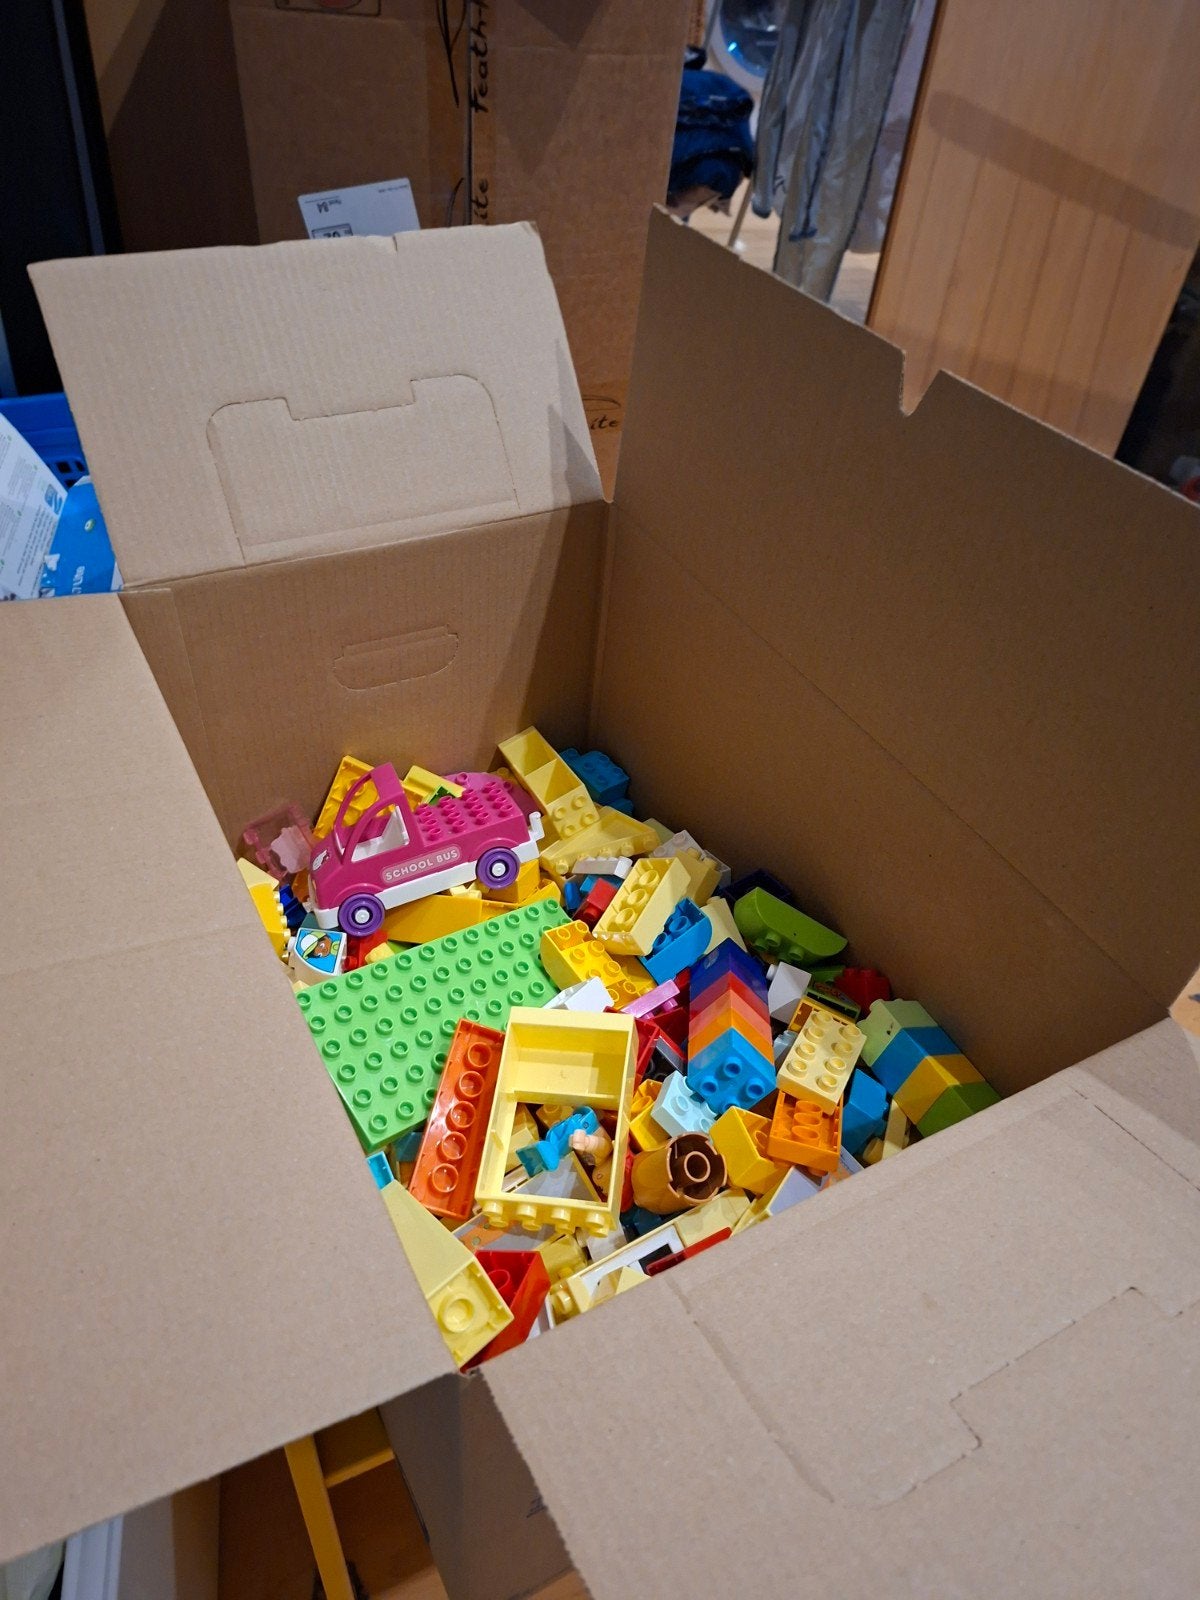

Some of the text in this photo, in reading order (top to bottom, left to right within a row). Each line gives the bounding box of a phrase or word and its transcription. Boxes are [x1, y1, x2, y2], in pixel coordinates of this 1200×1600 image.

[473, 179, 489, 220] ite
[590, 415, 619, 430] ite
[385, 849, 459, 881] SCHOOL BUS
